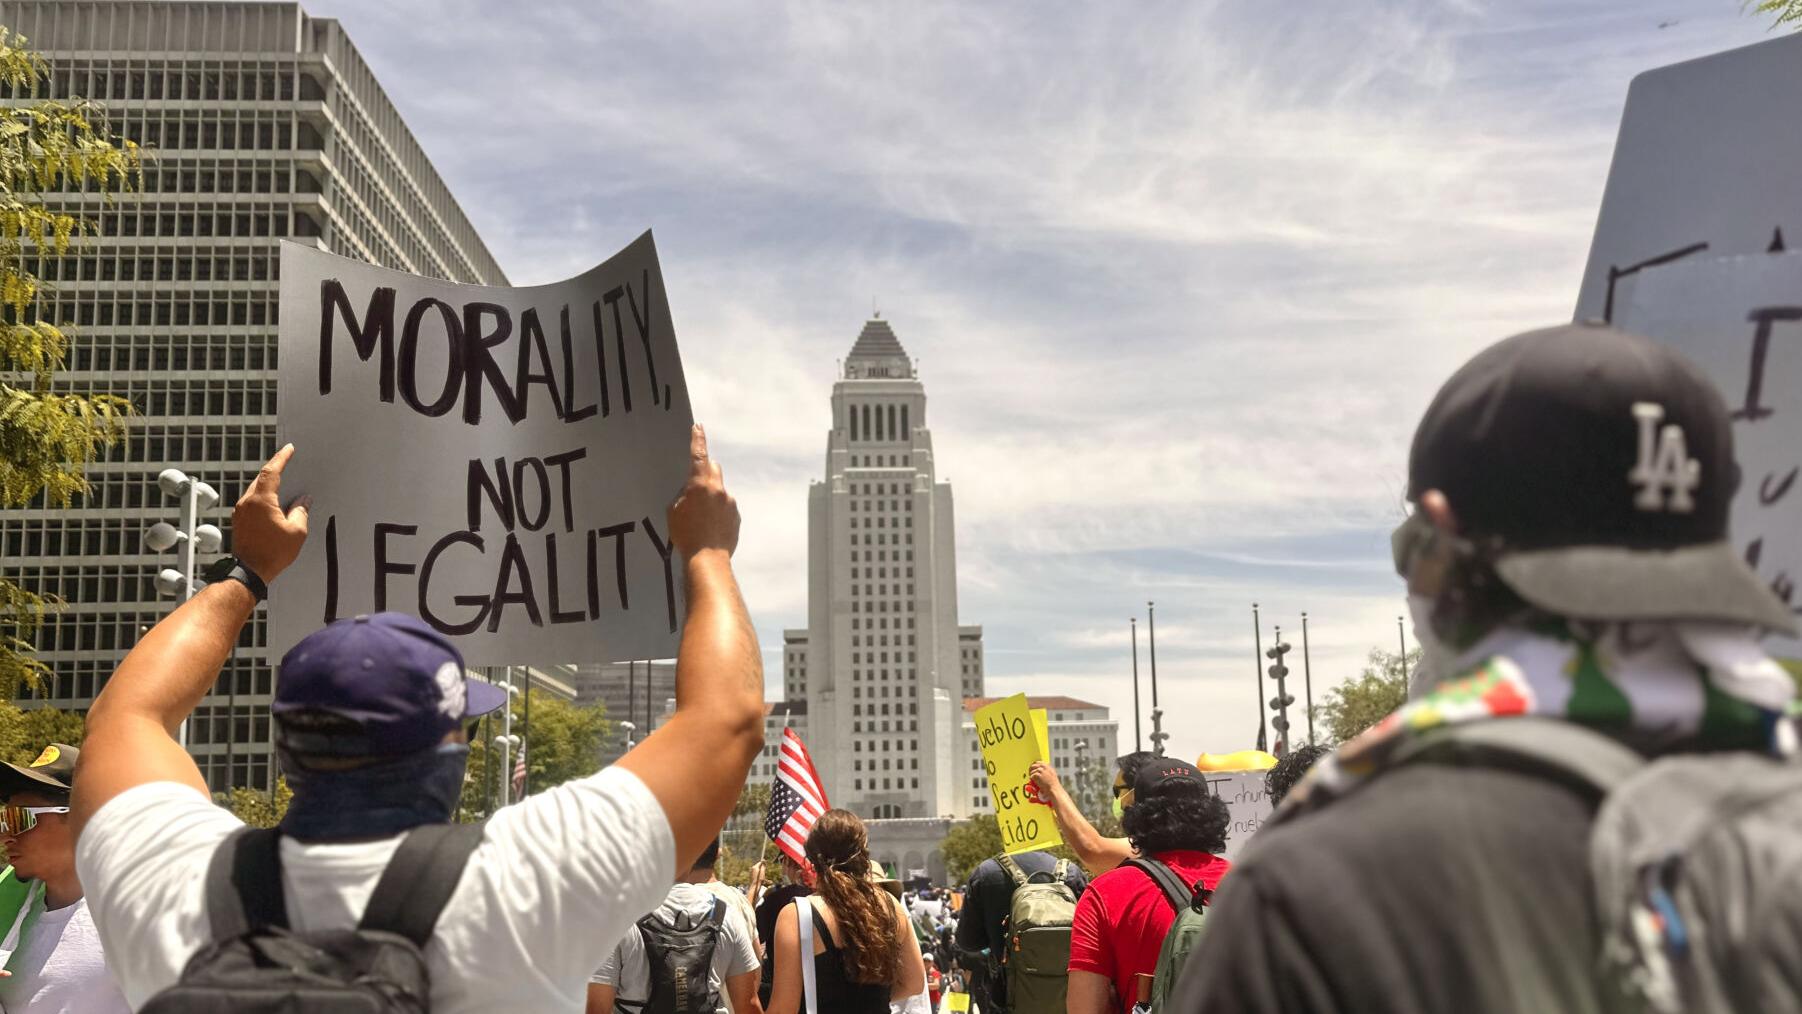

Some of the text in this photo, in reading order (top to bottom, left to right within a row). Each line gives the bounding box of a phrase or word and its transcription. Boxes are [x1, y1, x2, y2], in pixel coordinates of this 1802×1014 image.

[319, 269, 672, 425] MORALITY,
[467, 447, 587, 532] NOT
[1629, 402, 1701, 512] LA
[976, 713, 1025, 748] ueblo
